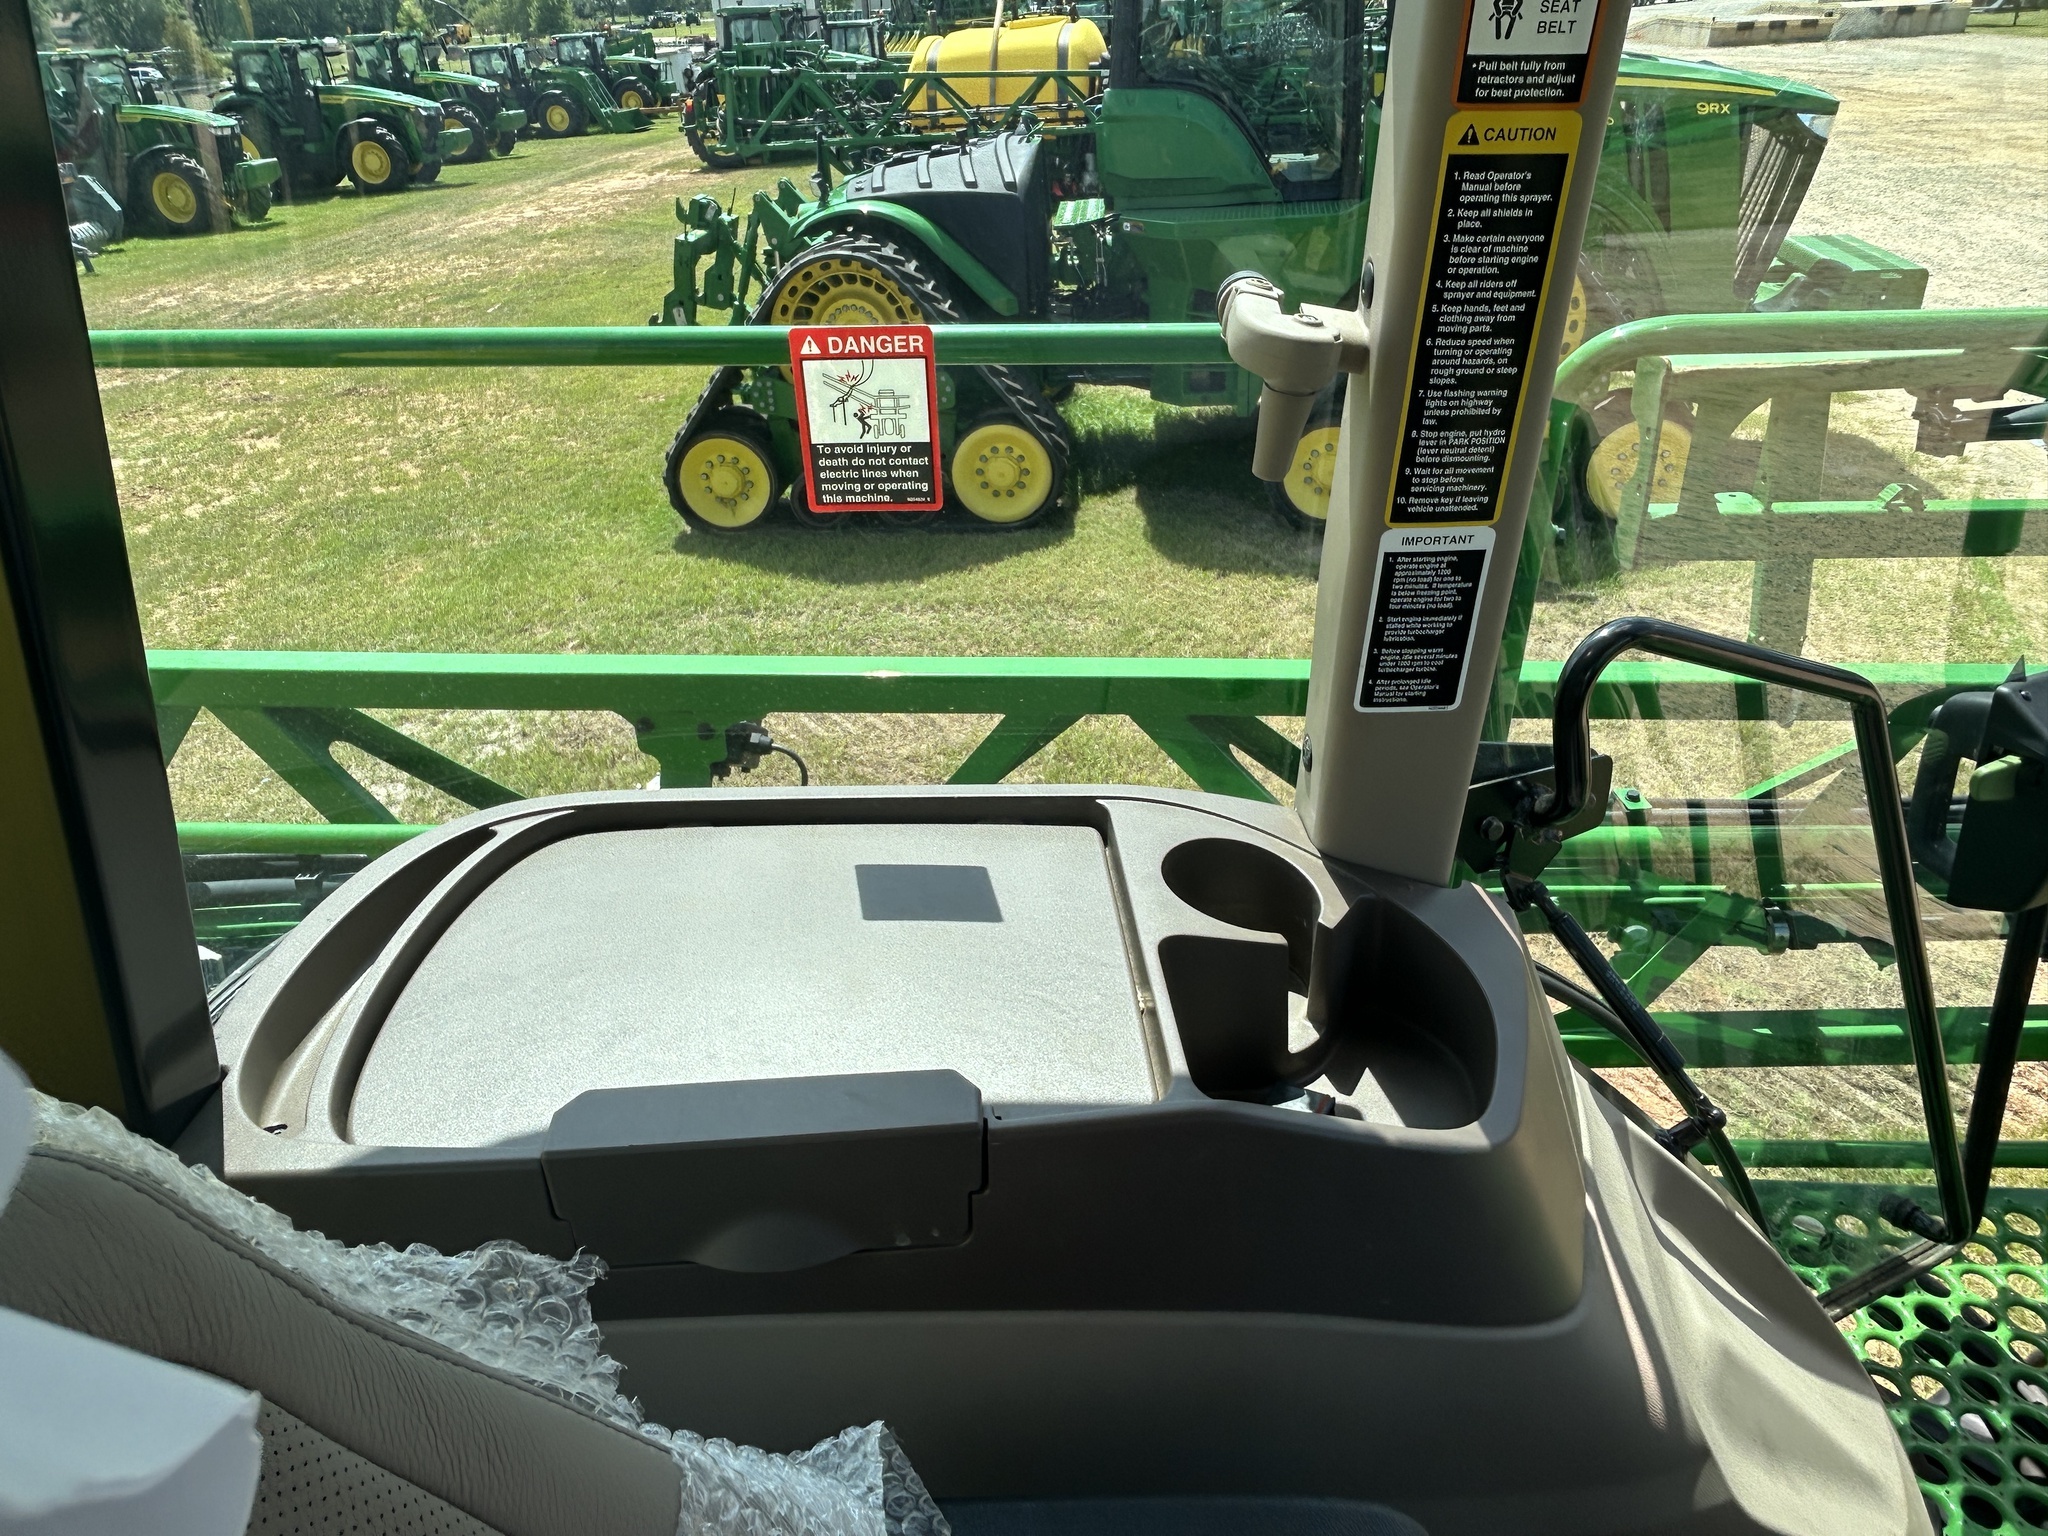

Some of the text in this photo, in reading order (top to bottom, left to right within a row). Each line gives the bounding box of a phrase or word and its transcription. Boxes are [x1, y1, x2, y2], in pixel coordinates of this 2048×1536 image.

[1540, 0, 1581, 13] SEAT
[1537, 21, 1576, 34] BELT
[1479, 61, 1565, 72] Pull belt fully from
[1478, 74, 1575, 86] retractors and adjust
[1476, 88, 1564, 99] for best protection.
[1696, 102, 1730, 115] 9RX
[1484, 128, 1556, 141] CAUTION
[1454, 172, 1532, 180] 1. Read Operator's
[1462, 182, 1521, 191] Manual before
[1460, 194, 1553, 203] operating this sprayer.
[1457, 209, 1478, 218] Keep
[1480, 208, 1491, 216] all
[1493, 208, 1523, 216] shields
[1525, 208, 1533, 216] in
[1457, 220, 1482, 230] place.
[1453, 235, 1474, 243] Make
[1476, 234, 1505, 242] certain
[1507, 235, 1545, 244] everyone
[1460, 245, 1481, 253] clear
[1449, 256, 1538, 265] before starting engine
[1458, 267, 1499, 276] operation.
[1445, 280, 1466, 290] Keep
[1468, 280, 1477, 288] all
[1443, 290, 1536, 300] sprayer and equipment.
[1441, 305, 1462, 314] Keep
[1464, 304, 1491, 313] hands,
[1493, 304, 1508, 312] feet
[1439, 315, 1472, 324] clothing
[1438, 325, 1492, 334] moving parts.
[828, 336, 924, 354] DANGER
[1436, 338, 1466, 346] Reduce
[1468, 338, 1491, 347] speed
[1434, 348, 1462, 357] turning
[1475, 348, 1512, 356] operating
[1431, 368, 1454, 376] rough
[1456, 368, 1484, 376] ground
[1497, 367, 1517, 376] steep
[1429, 377, 1457, 385] slopes.
[1444, 390, 1475, 398] flashing
[1477, 389, 1507, 398] warning
[1461, 399, 1493, 408] highway
[1451, 408, 1490, 417] prohibited
[1421, 430, 1438, 438] Stop
[817, 444, 911, 455] To avoid injury or
[1468, 446, 1494, 454] detent)
[819, 458, 848, 466] death
[852, 457, 865, 466] do
[889, 457, 928, 465] contact
[1442, 454, 1490, 464] dismounting.
[820, 469, 918, 478] electric lines when
[1456, 466, 1494, 474] movement
[1422, 476, 1438, 484] stop
[822, 481, 928, 492] moving or operating
[1411, 485, 1445, 493] servicing
[823, 493, 893, 503] this machine.
[1462, 496, 1488, 504] leaving
[1435, 504, 1478, 512] unattended.
[1402, 535, 1474, 546] IMPORTANT
